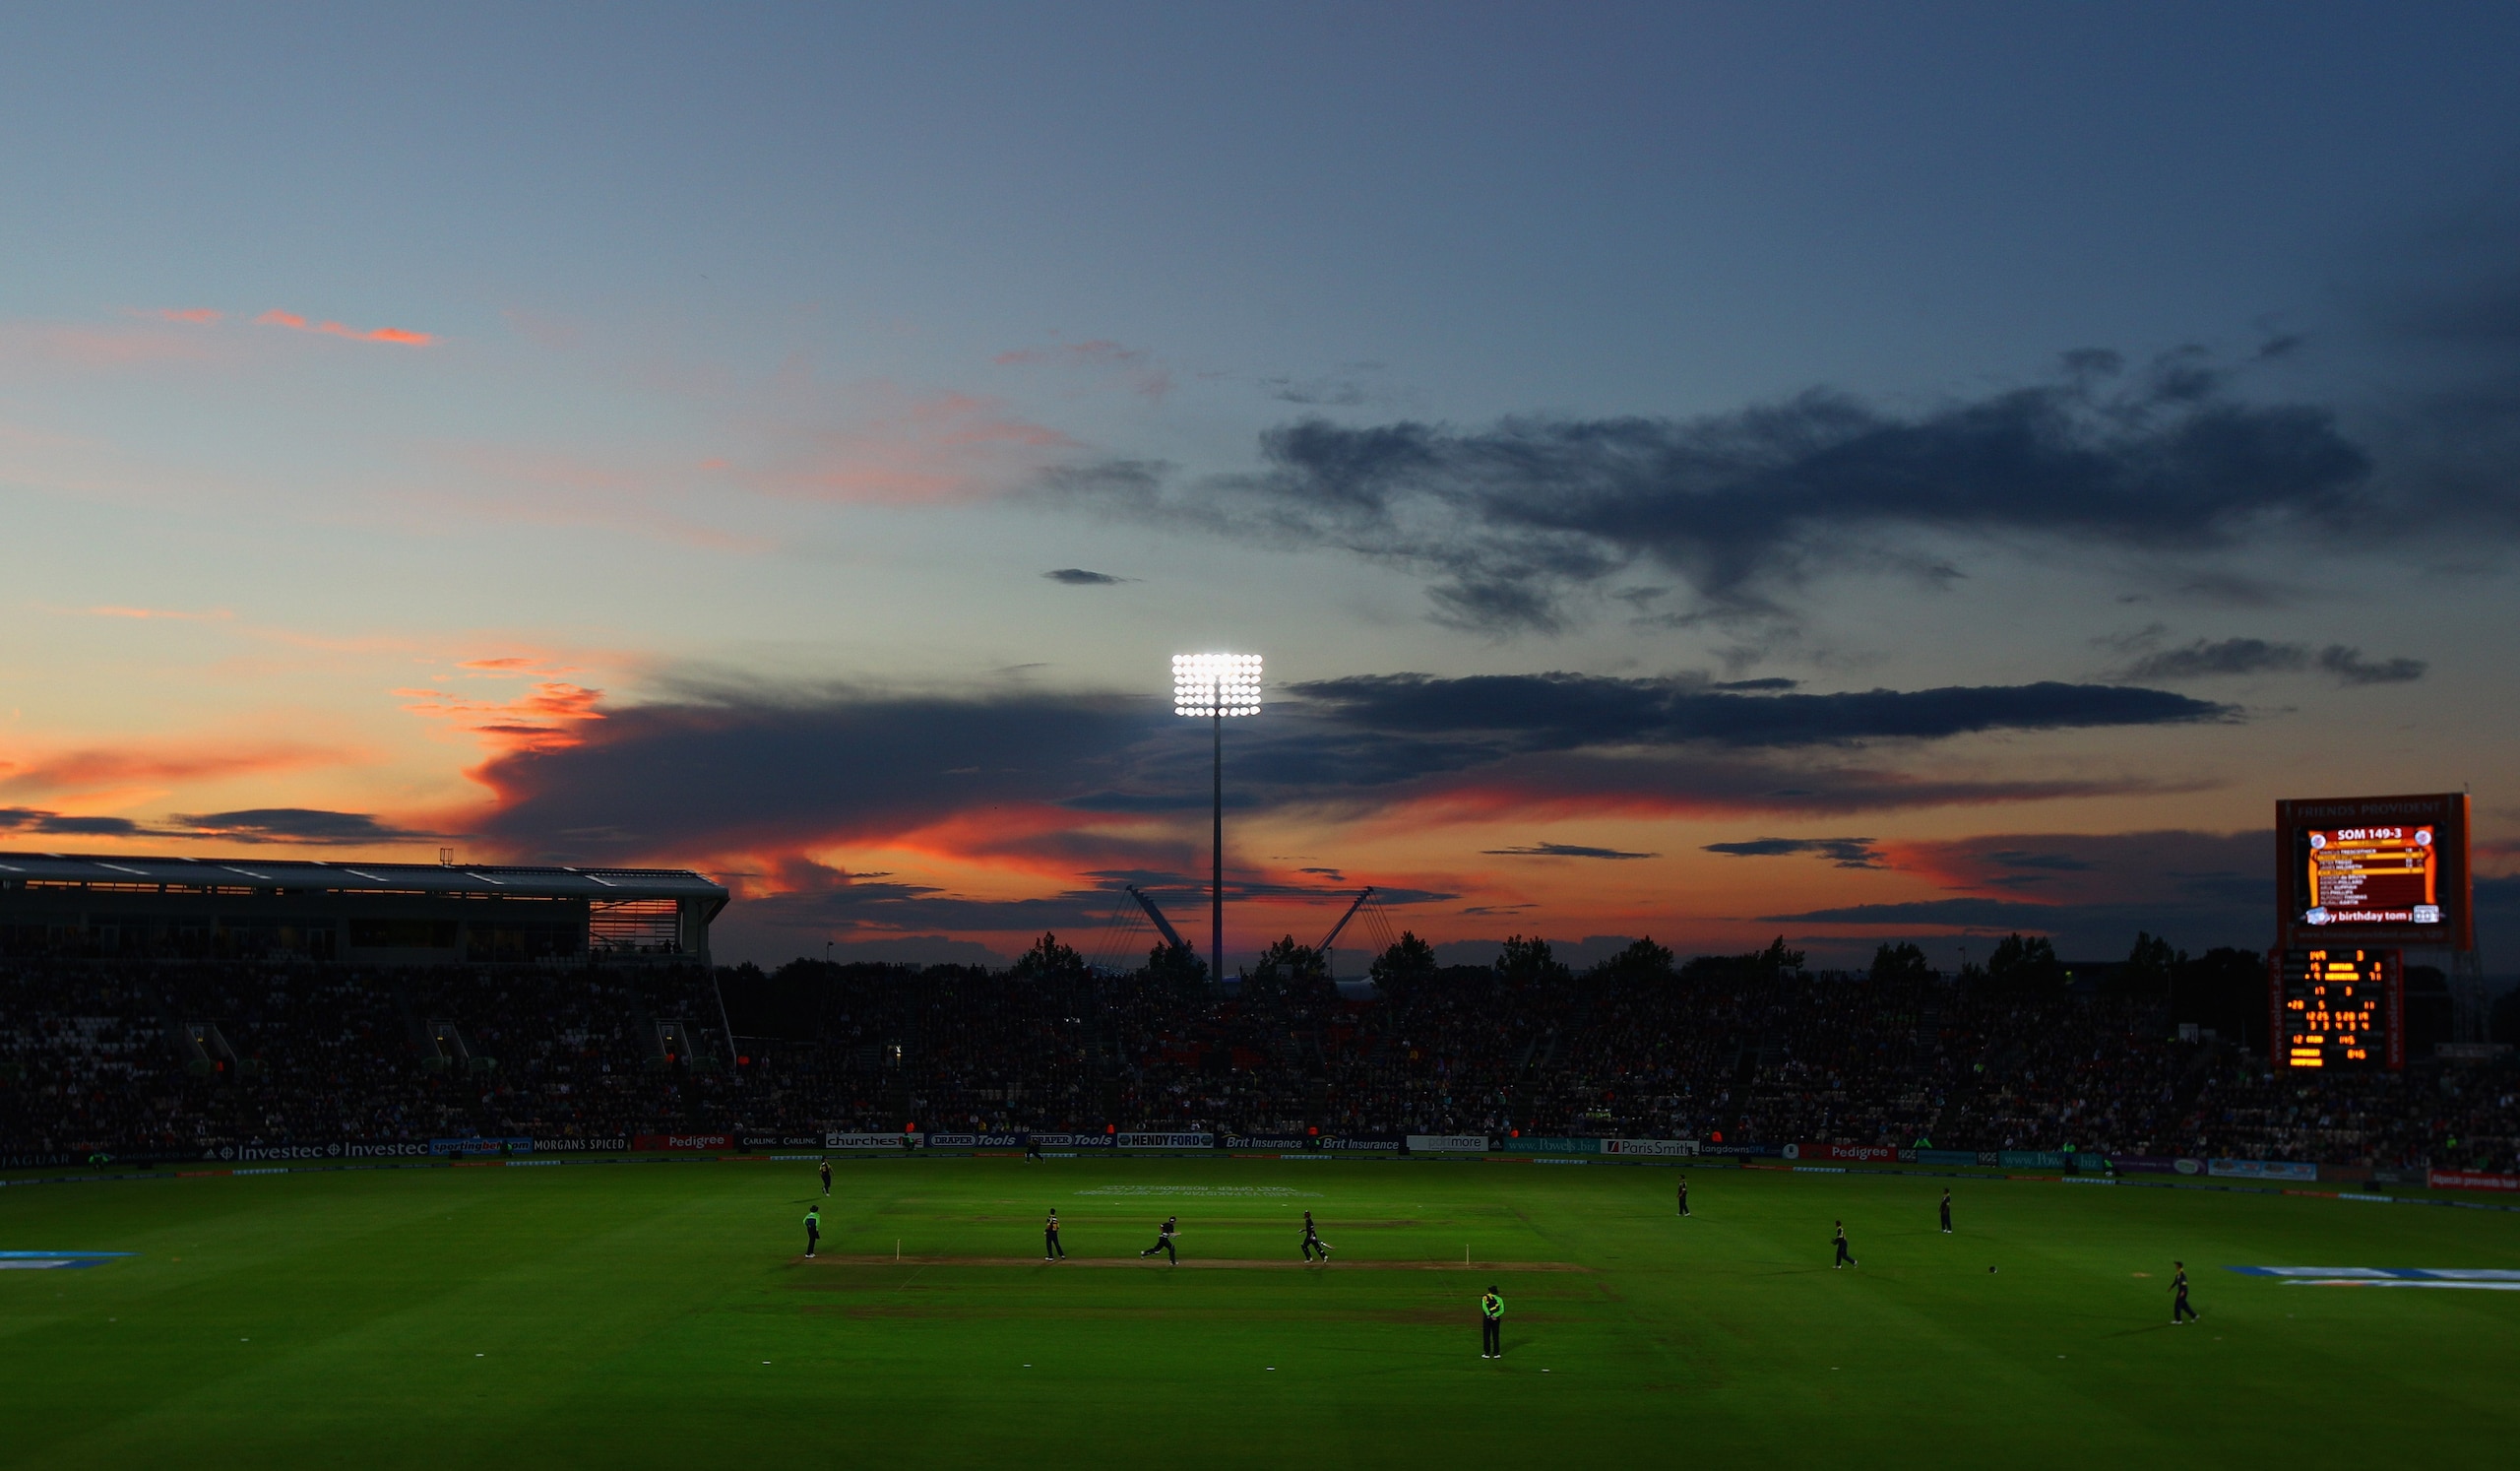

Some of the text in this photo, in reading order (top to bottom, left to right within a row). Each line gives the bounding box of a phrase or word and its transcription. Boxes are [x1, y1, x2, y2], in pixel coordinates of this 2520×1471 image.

[2298, 800, 2441, 817] FRIENDS PROVIDENT
[2337, 827, 2402, 841] SOM 149-3
[2339, 911, 2382, 923] birthday
[2384, 912, 2407, 921] tom
[433, 1140, 530, 1152] sportingbetom
[534, 1137, 625, 1150] MORGAN'S SPICED
[668, 1135, 724, 1149] Pedigree
[743, 1136, 777, 1146] CARLING
[784, 1136, 816, 1145] CARLING
[827, 1134, 922, 1146] churchesfe
[935, 1134, 1016, 1146] DRAPER Tools
[1074, 1134, 1112, 1146] Tools
[1227, 1136, 1302, 1149] Brit Insurance
[1323, 1137, 1399, 1150] Brit Insurance
[1428, 1135, 1481, 1151] portmore
[238, 1144, 323, 1160] Investec
[345, 1141, 428, 1157] Investec
[1622, 1140, 1689, 1155] Paris Smith
[1832, 1146, 1888, 1160] Pedigree
[1, 1153, 70, 1168] JAGUAR
